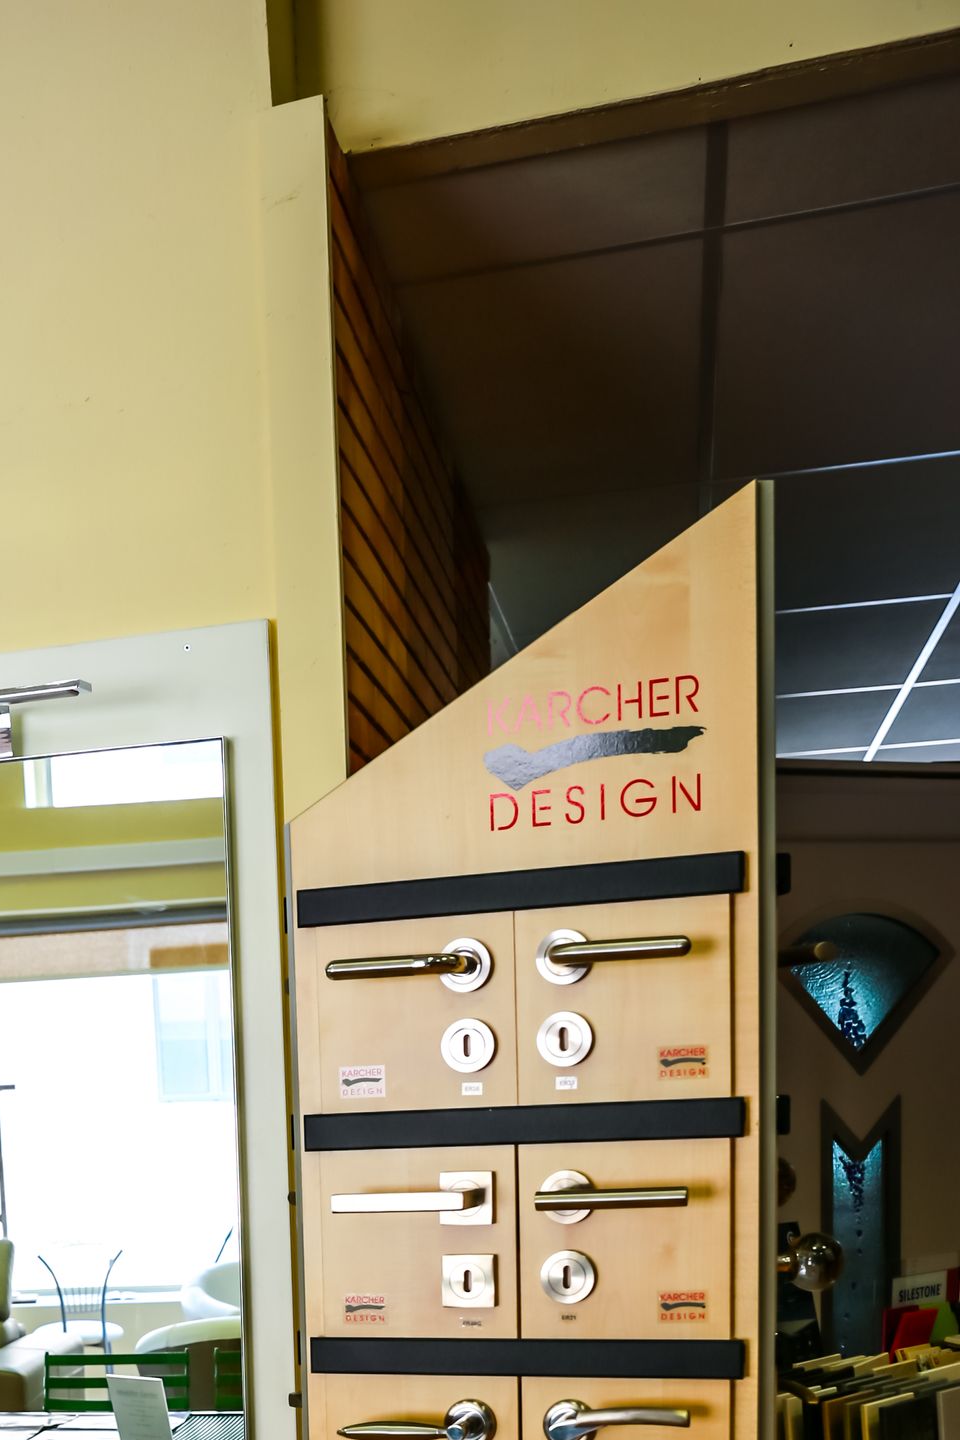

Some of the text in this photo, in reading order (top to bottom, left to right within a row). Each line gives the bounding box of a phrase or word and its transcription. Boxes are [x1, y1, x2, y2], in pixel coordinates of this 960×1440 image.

[486, 674, 700, 737] KARCHER
[489, 772, 702, 832] DESIGN
[659, 1047, 705, 1058] KARCHER
[341, 1068, 382, 1078] KARCHER
[660, 1068, 706, 1078] DESIGN
[342, 1087, 383, 1096] DESIGN
[660, 1291, 705, 1301] KARCHER
[898, 1283, 941, 1303] SILESTONE
[345, 1295, 385, 1304] KARCHER
[345, 1314, 385, 1322] DESIGN
[660, 1311, 705, 1321] DESIGN
